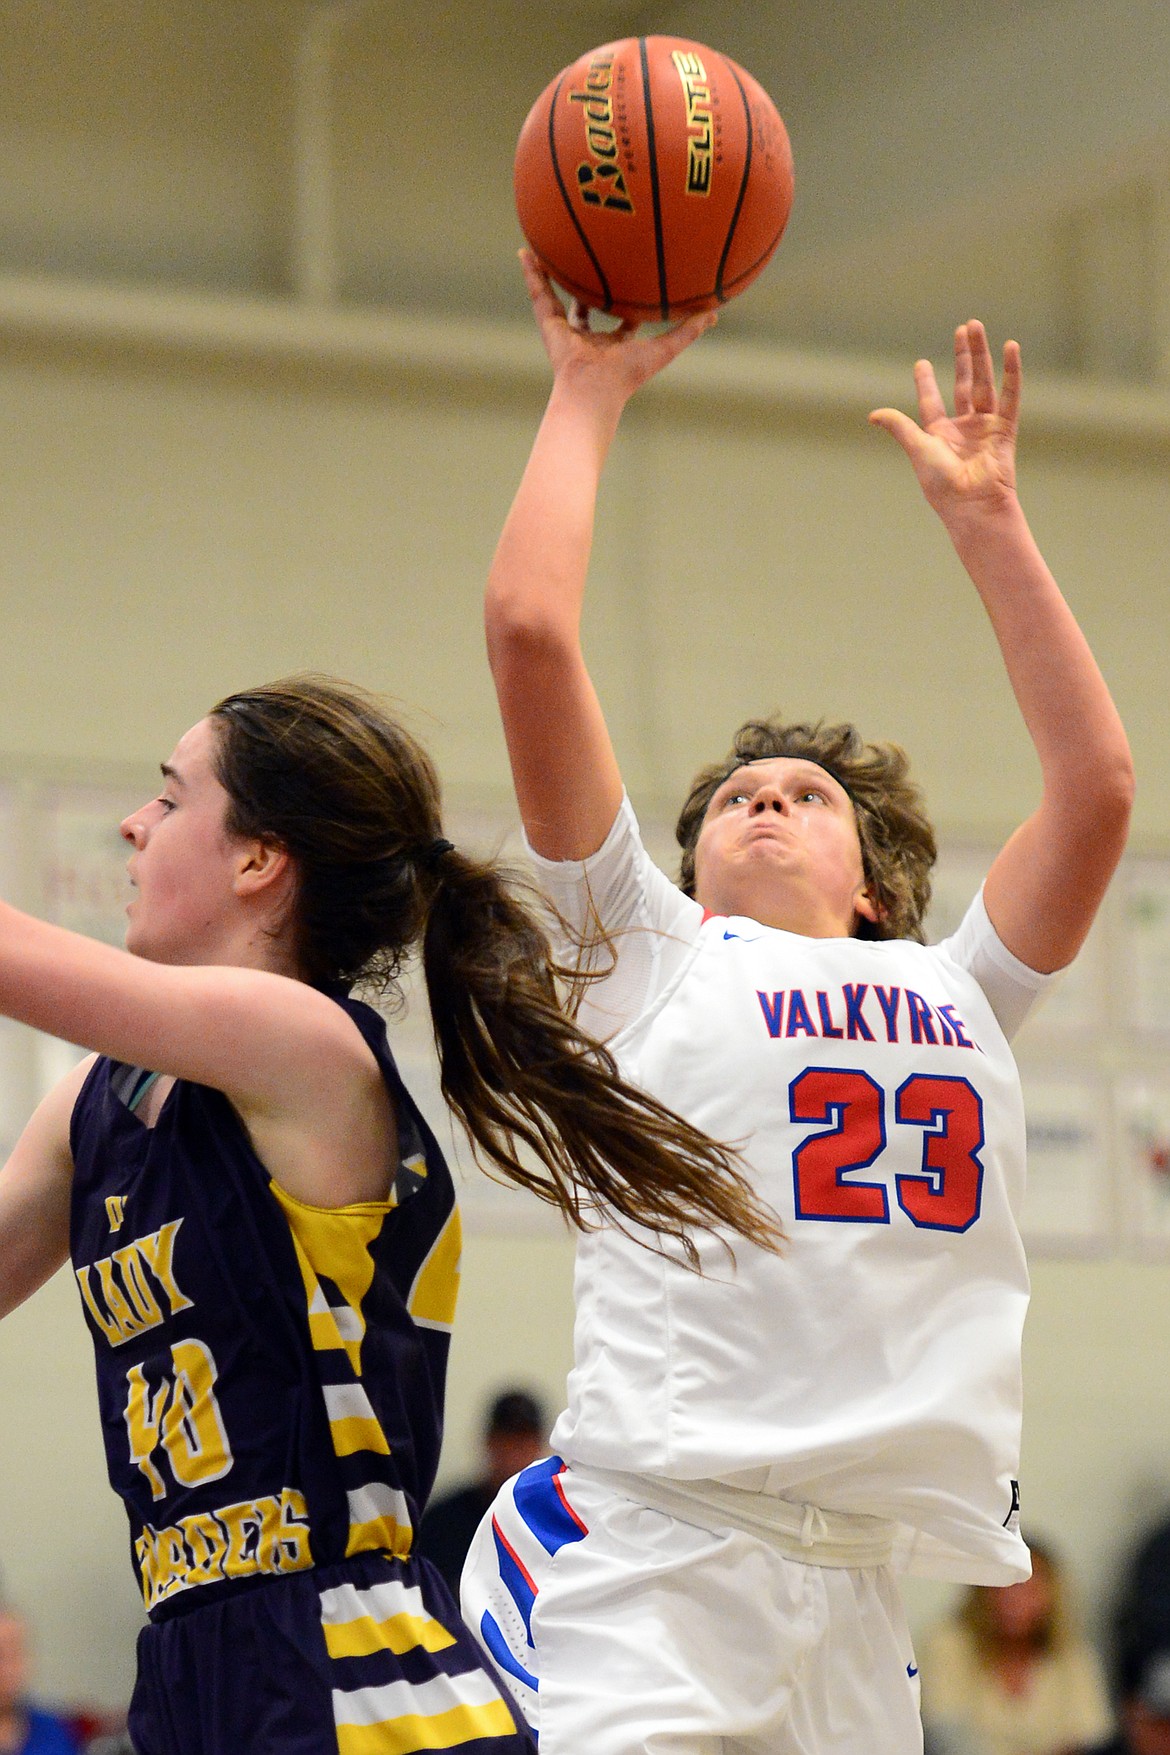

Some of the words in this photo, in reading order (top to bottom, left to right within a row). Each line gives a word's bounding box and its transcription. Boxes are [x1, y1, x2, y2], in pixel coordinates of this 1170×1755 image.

[568, 52, 635, 215] Baden
[671, 49, 714, 198] ELITE
[756, 983, 985, 1054] VALKYRIE
[788, 1066, 986, 1234] 23
[75, 1217, 195, 1348] LADY
[123, 1338, 235, 1502] 40
